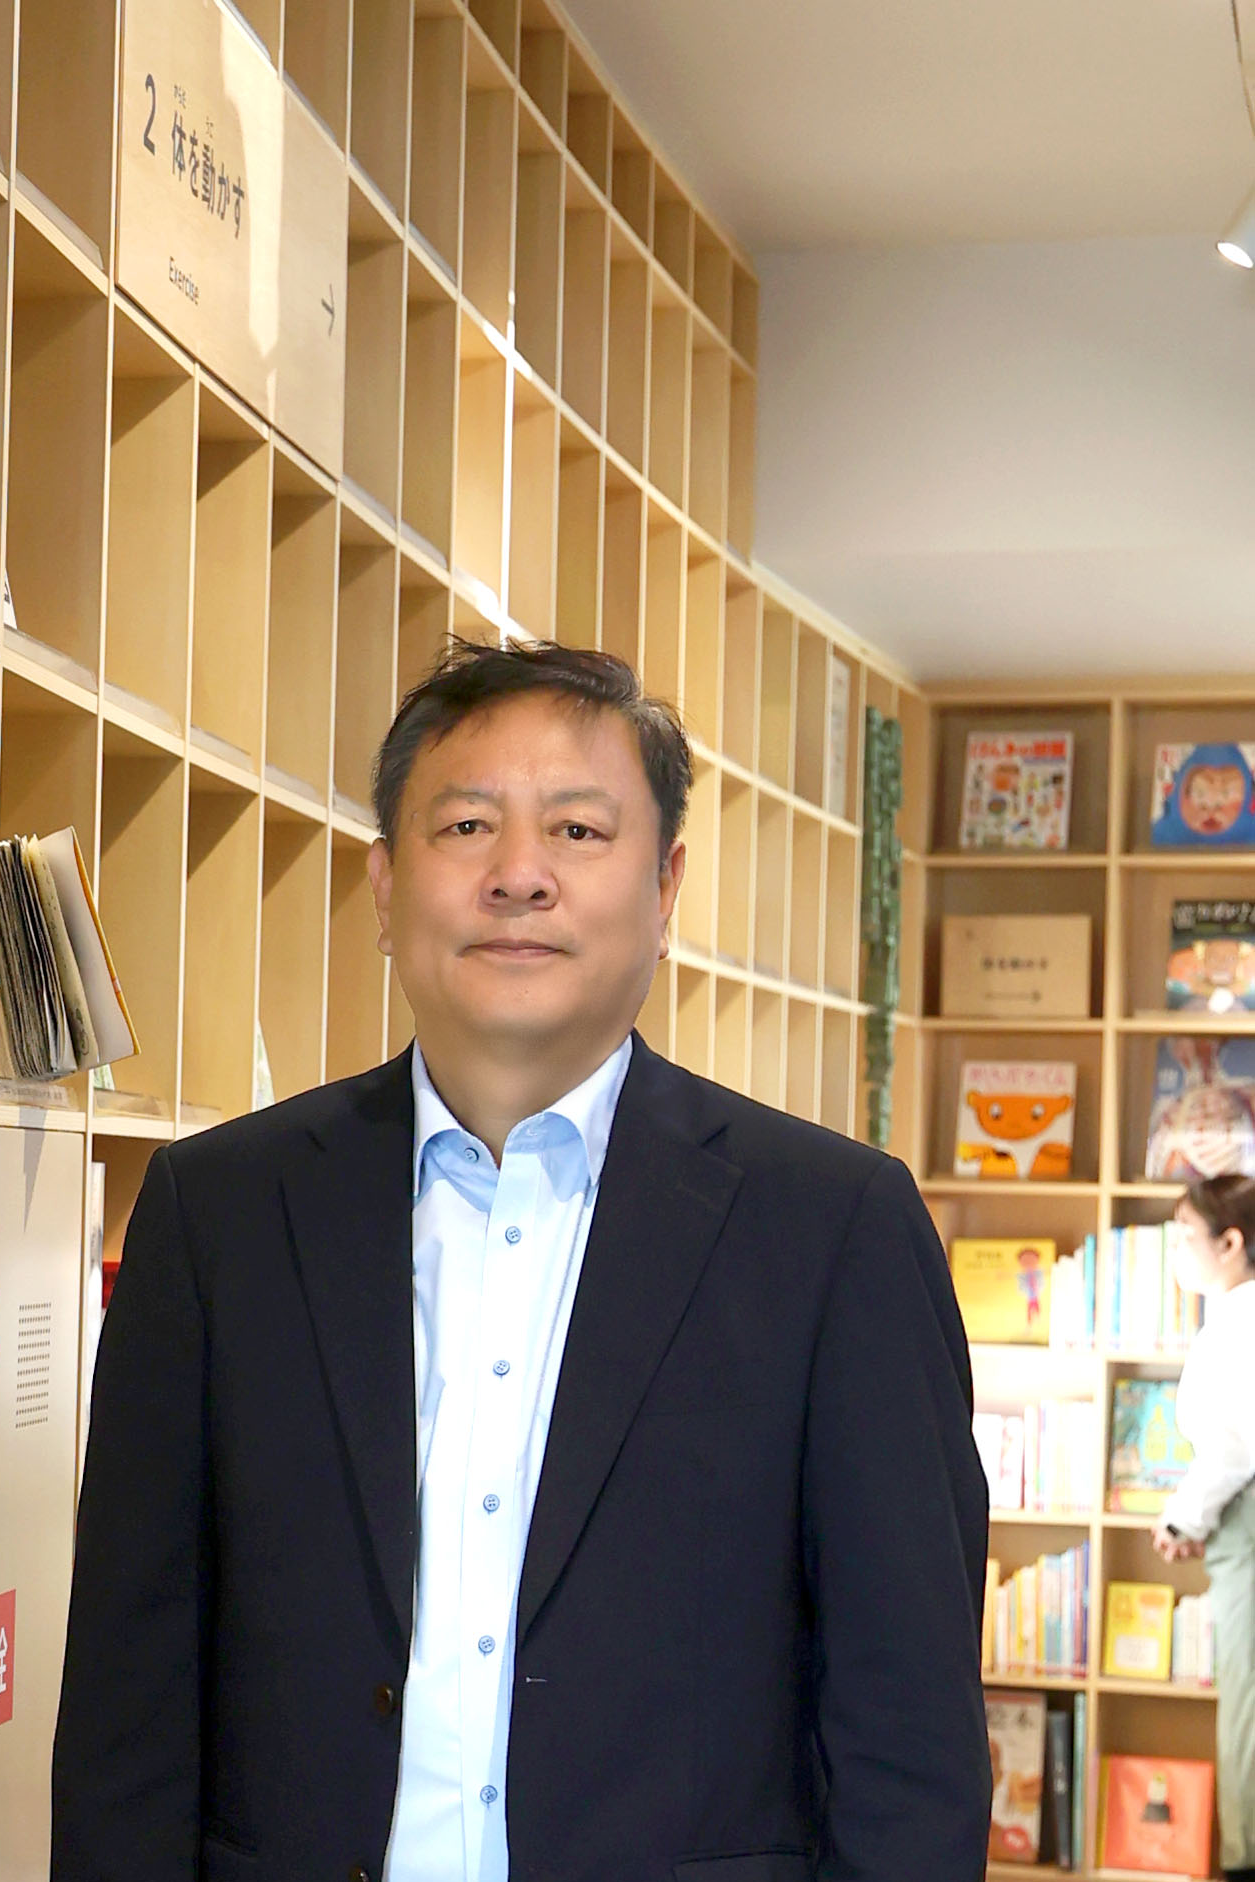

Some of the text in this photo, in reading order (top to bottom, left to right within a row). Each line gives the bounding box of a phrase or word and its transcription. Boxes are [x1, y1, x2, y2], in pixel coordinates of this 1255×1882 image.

[143, 73, 245, 240] 2 体を動かす
[168, 255, 199, 306] Exercise
